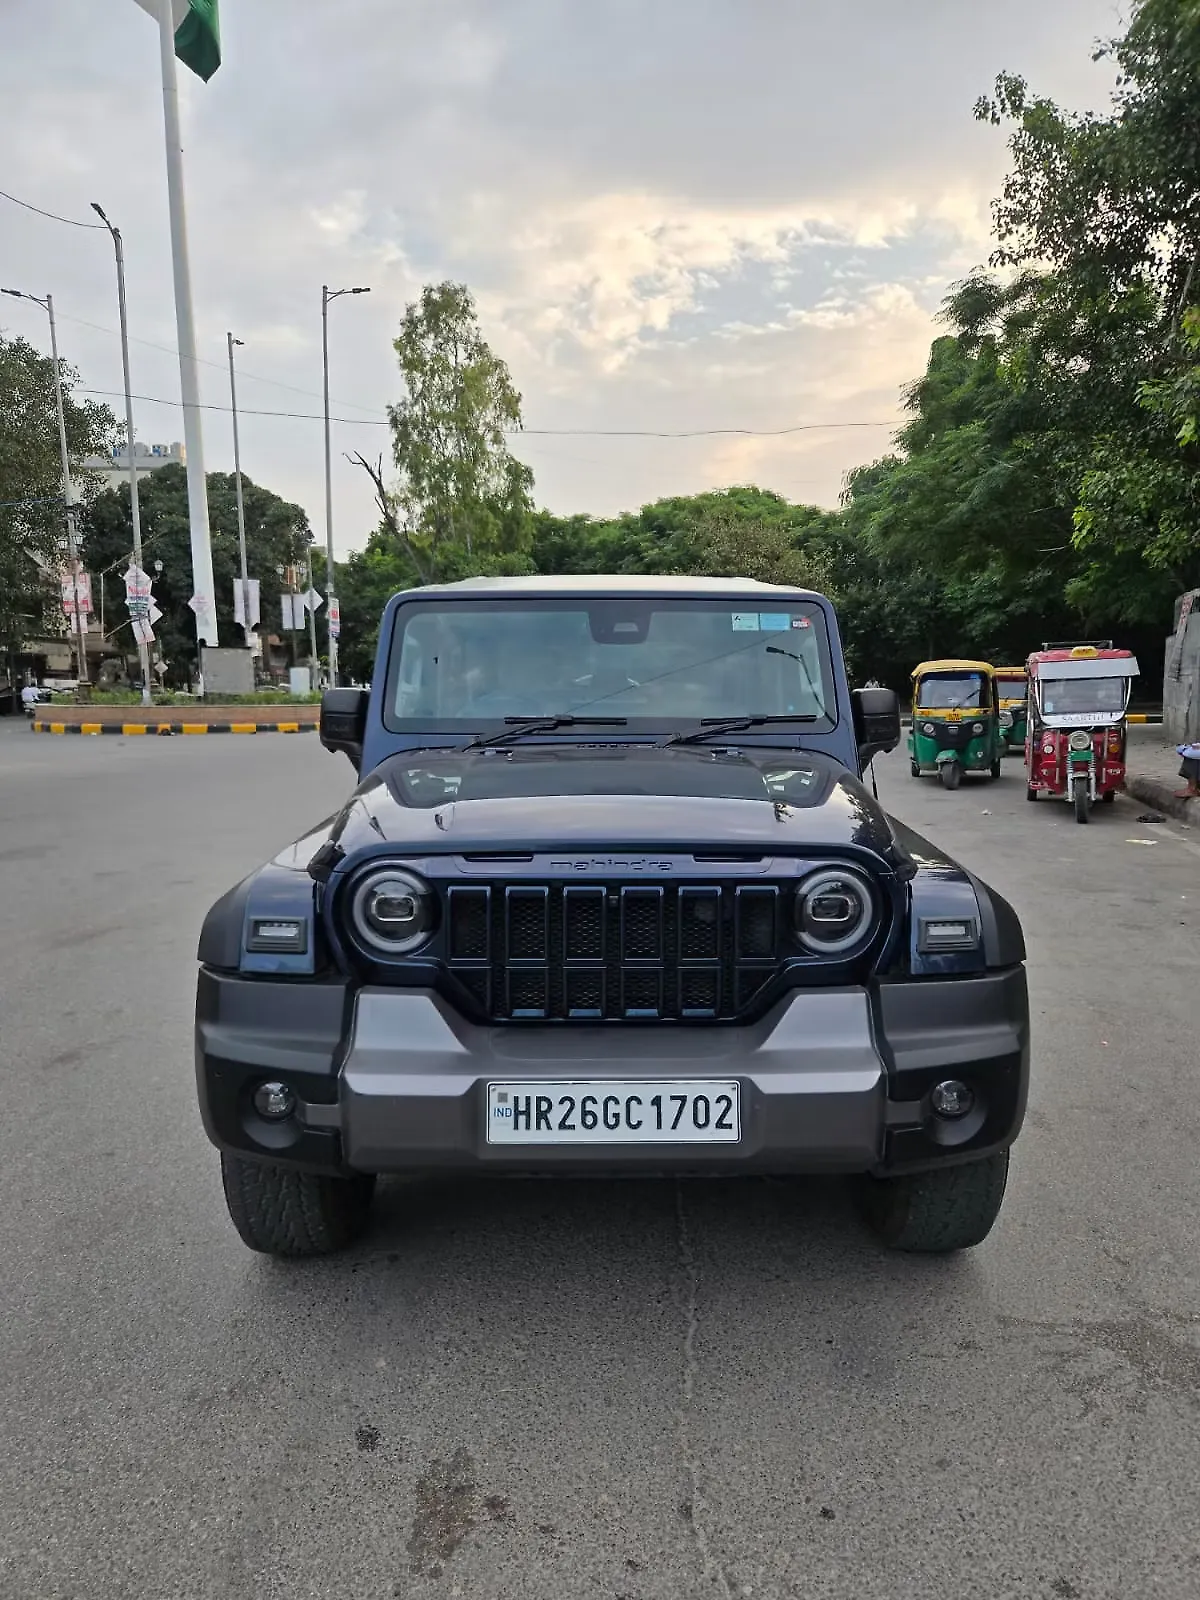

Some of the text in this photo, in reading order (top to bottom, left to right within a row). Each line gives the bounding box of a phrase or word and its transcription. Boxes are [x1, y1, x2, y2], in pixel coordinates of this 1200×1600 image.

[550, 858, 673, 872] mahindra
[494, 1095, 733, 1131] IND HR26GC1702
